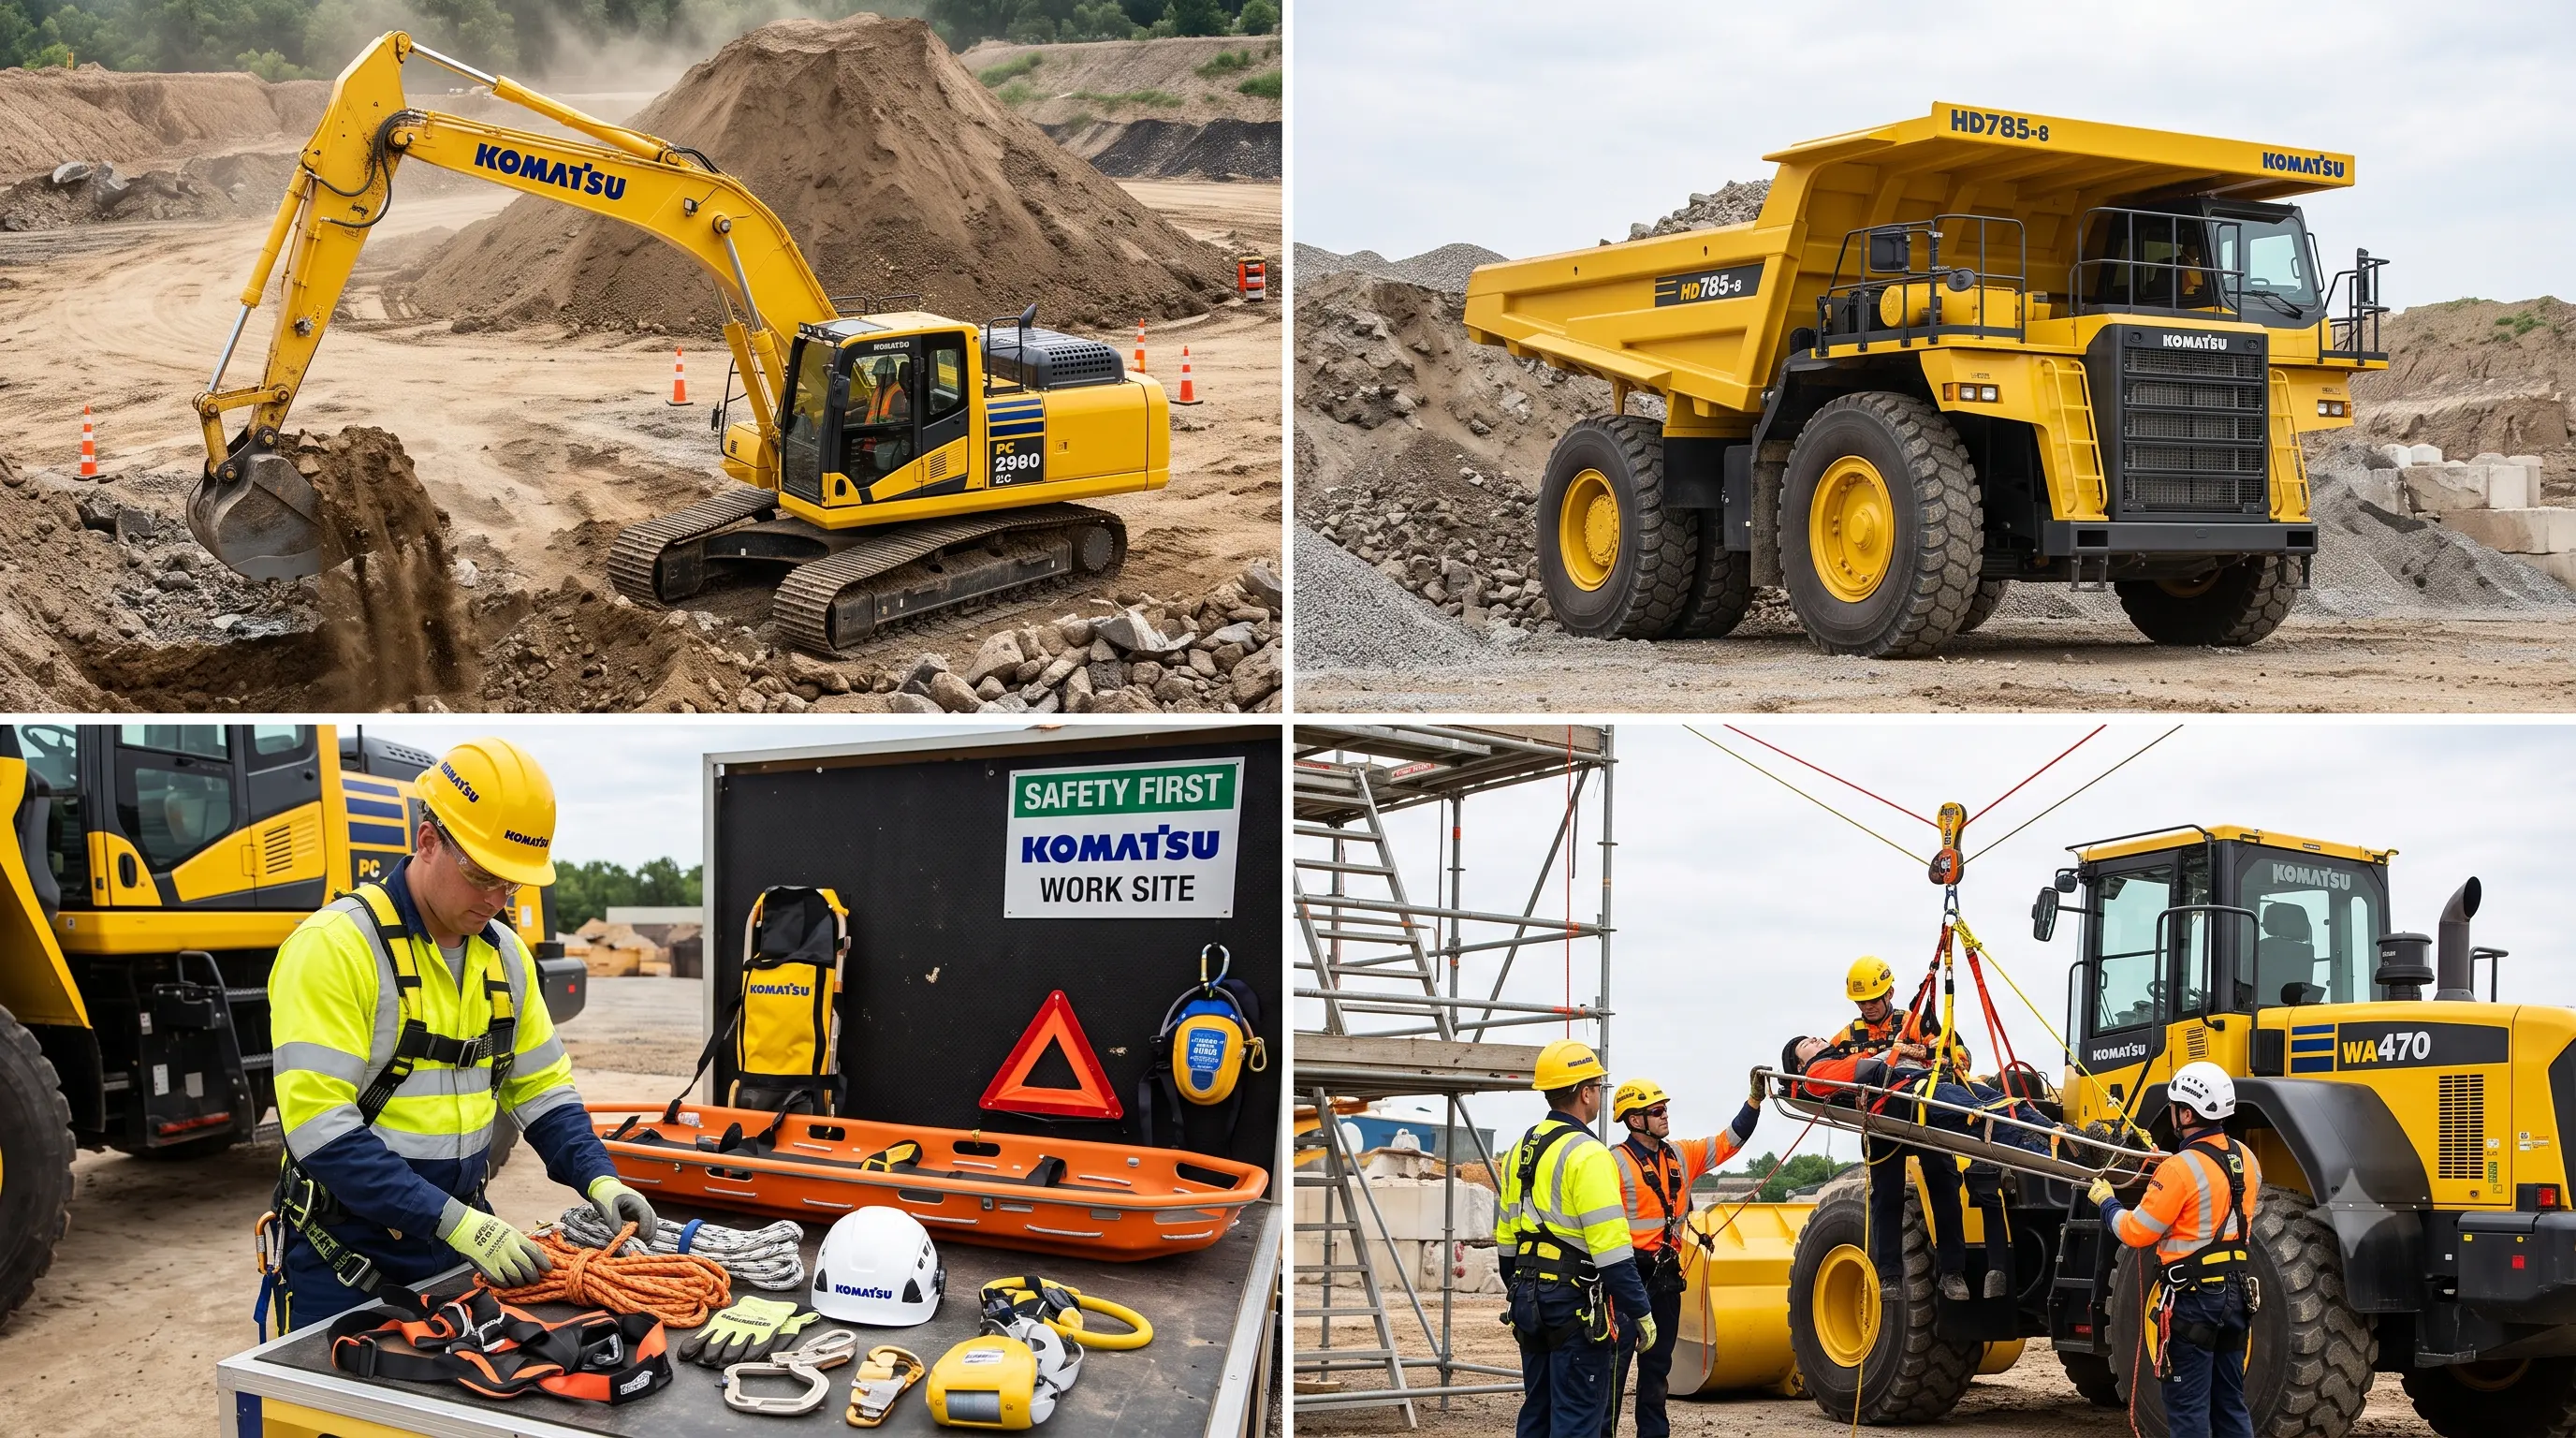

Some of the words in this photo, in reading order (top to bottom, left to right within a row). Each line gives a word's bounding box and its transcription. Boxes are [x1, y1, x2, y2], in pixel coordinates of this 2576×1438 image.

[1951, 109, 2049, 142] HD785-8
[474, 142, 627, 200] KOMATSU
[2262, 152, 2344, 178] KOMATSU
[1679, 273, 1742, 301] HD785-8
[2162, 333, 2228, 350] KOMATSU
[995, 442, 1015, 455] PC
[1024, 778, 1131, 811] SAFETY
[1138, 772, 1223, 805] FIRST
[1021, 824, 1220, 863] KOMATSU
[358, 858, 381, 877] PC
[2272, 863, 2351, 891] KOMATSU
[1040, 876, 1123, 902] WORK
[1132, 874, 1195, 902] SITE
[750, 983, 810, 996] KOMATSU
[2092, 1042, 2146, 1061] KOMATSU
[2342, 1031, 2431, 1064] WA470
[835, 1284, 893, 1299] KOMATSU
